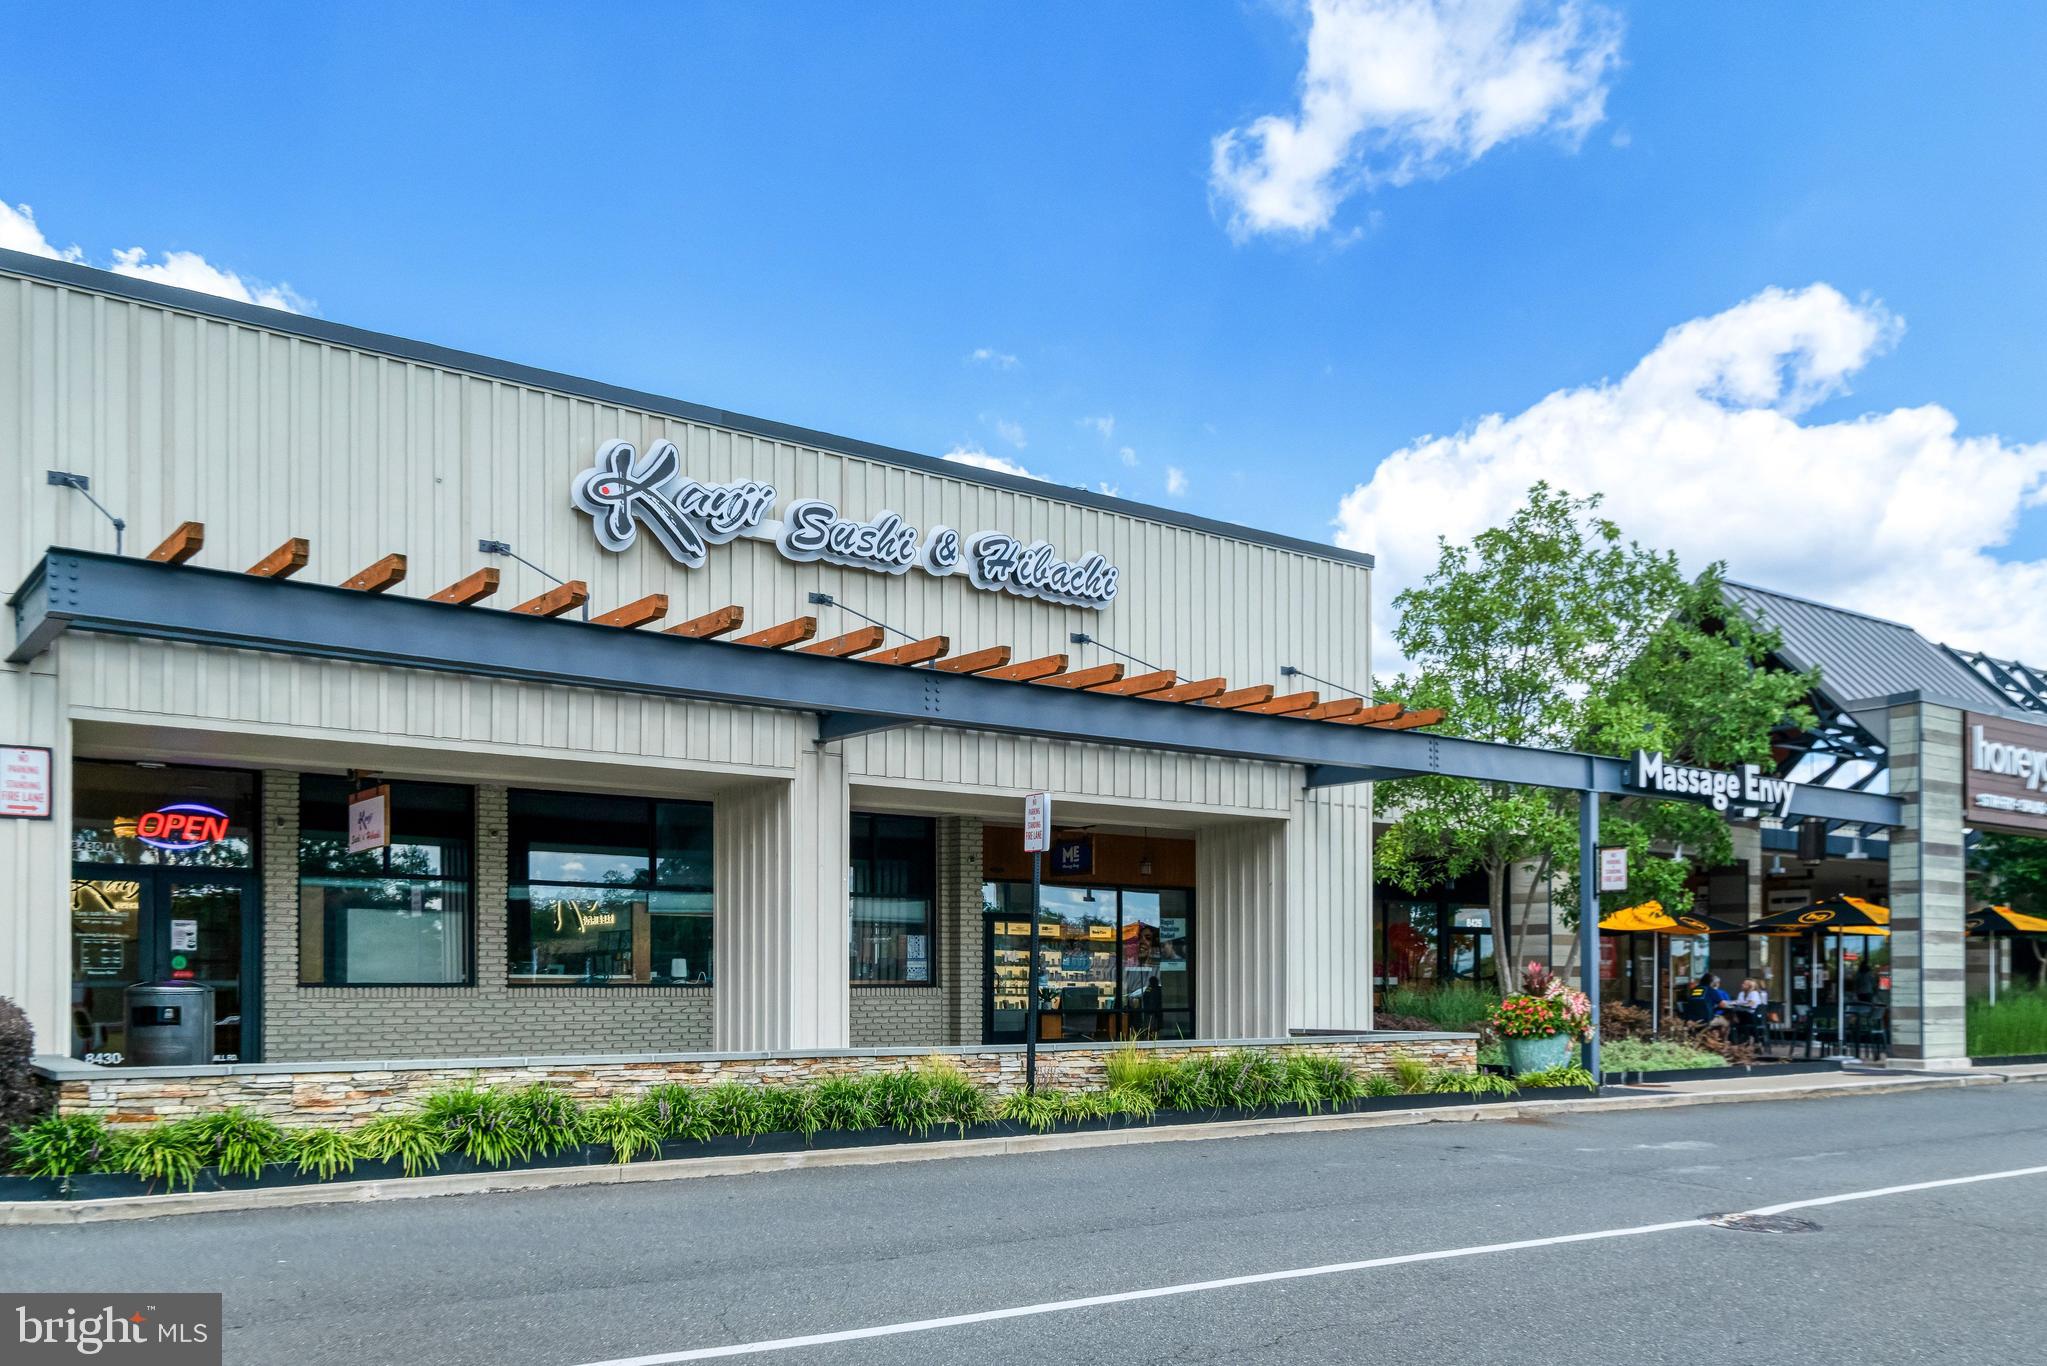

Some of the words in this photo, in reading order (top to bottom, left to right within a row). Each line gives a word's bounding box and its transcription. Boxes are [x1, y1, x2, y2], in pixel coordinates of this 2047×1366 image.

[791, 502, 918, 566] Sushi
[934, 529, 960, 566] &
[978, 534, 1119, 600] Hibachi
[1637, 748, 1741, 811] Massage
[1744, 763, 1796, 818] Envy
[137, 812, 230, 842] OPEN
